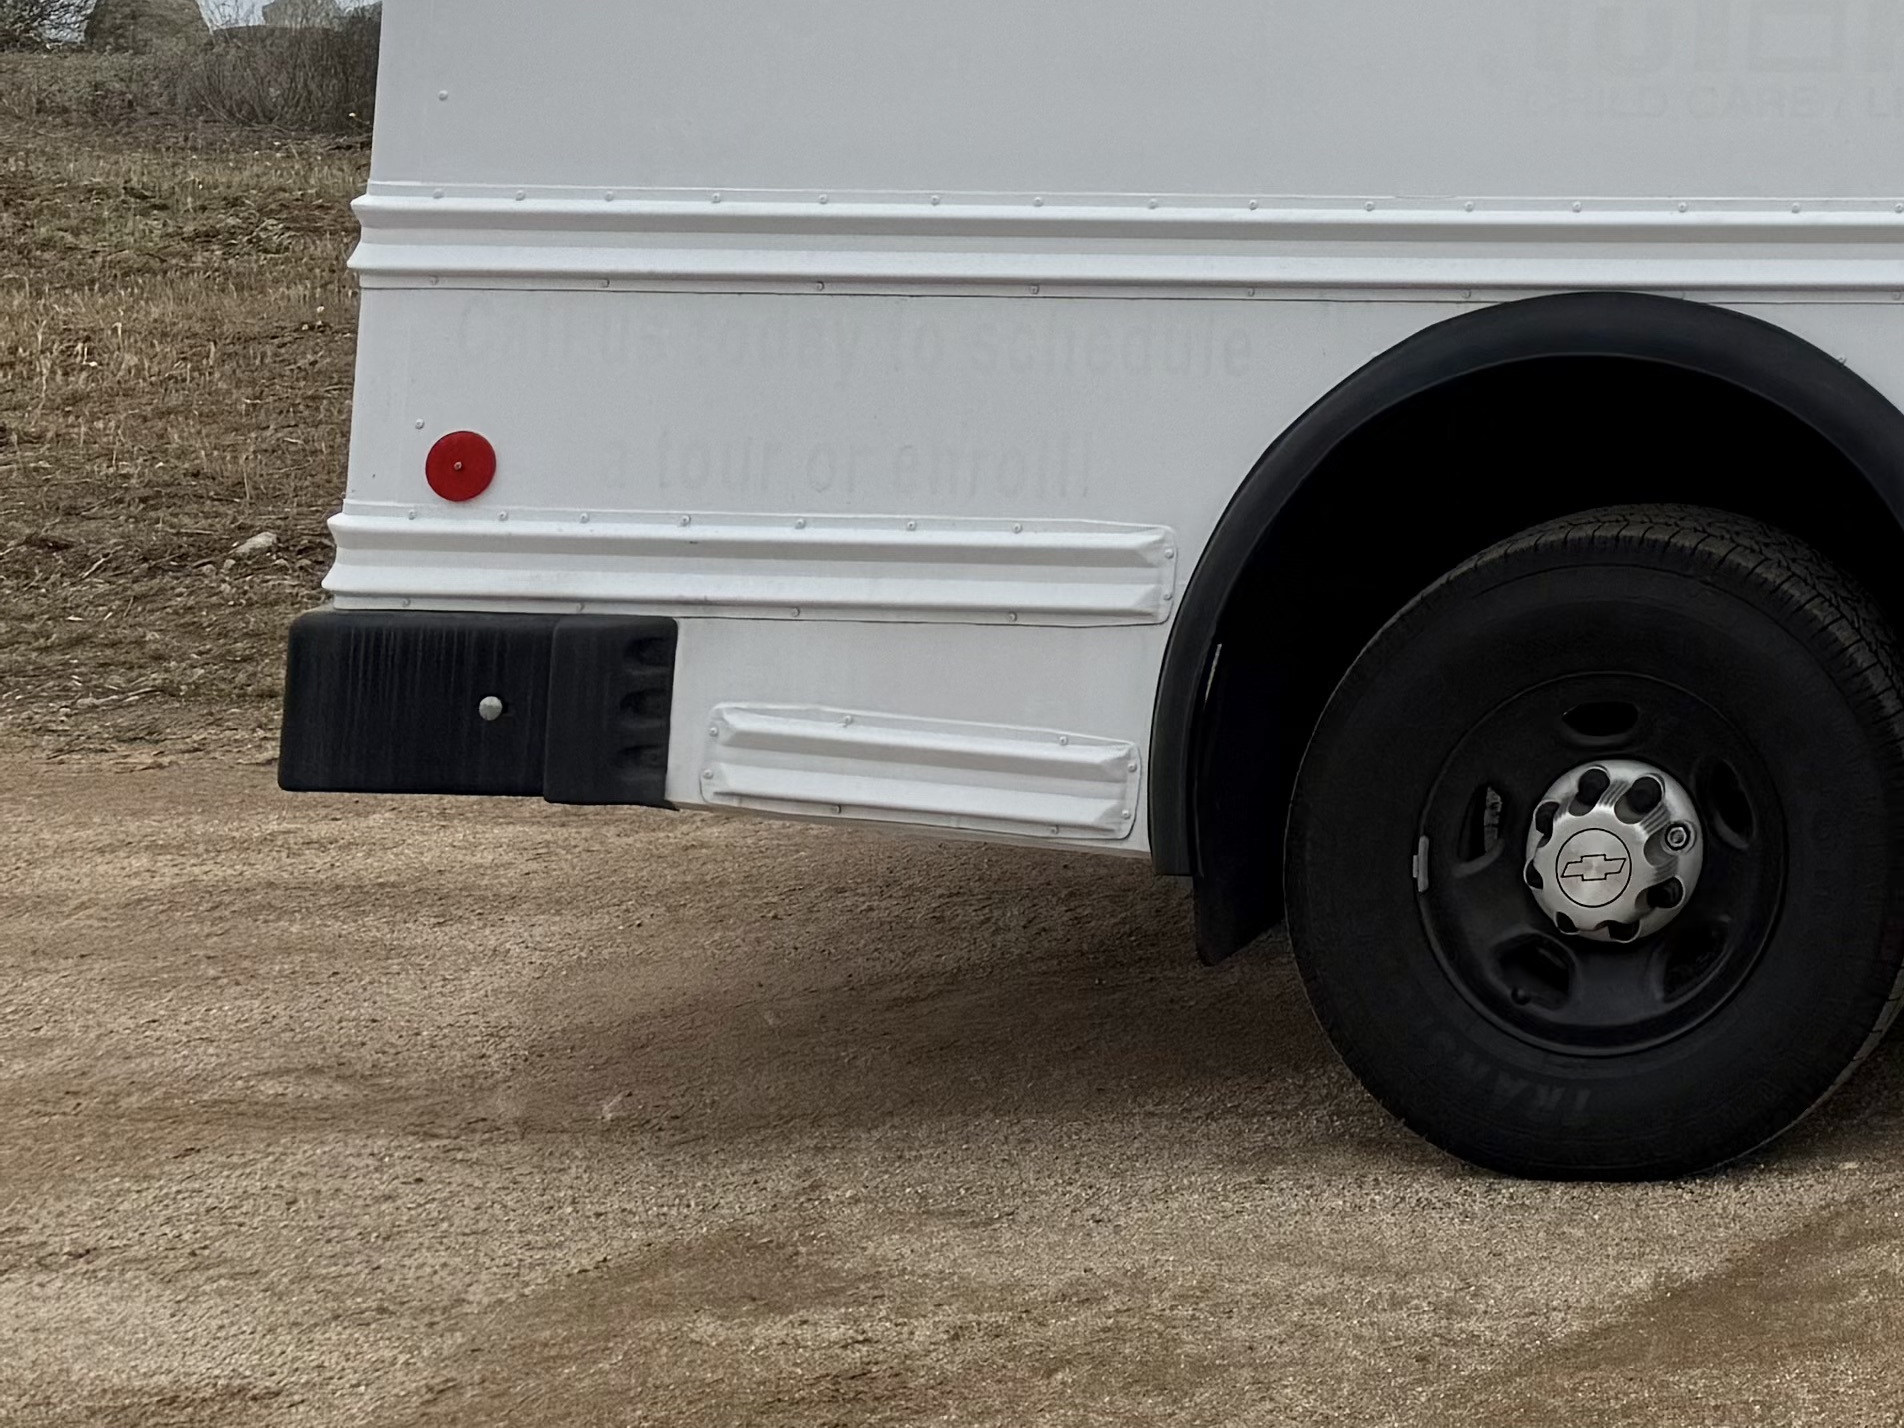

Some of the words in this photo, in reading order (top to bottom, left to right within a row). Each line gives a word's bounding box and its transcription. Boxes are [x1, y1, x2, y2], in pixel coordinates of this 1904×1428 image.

[1524, 85, 1669, 119] CHILD
[1685, 85, 1821, 120] CARE
[657, 424, 784, 492] tour
[804, 439, 873, 494] or
